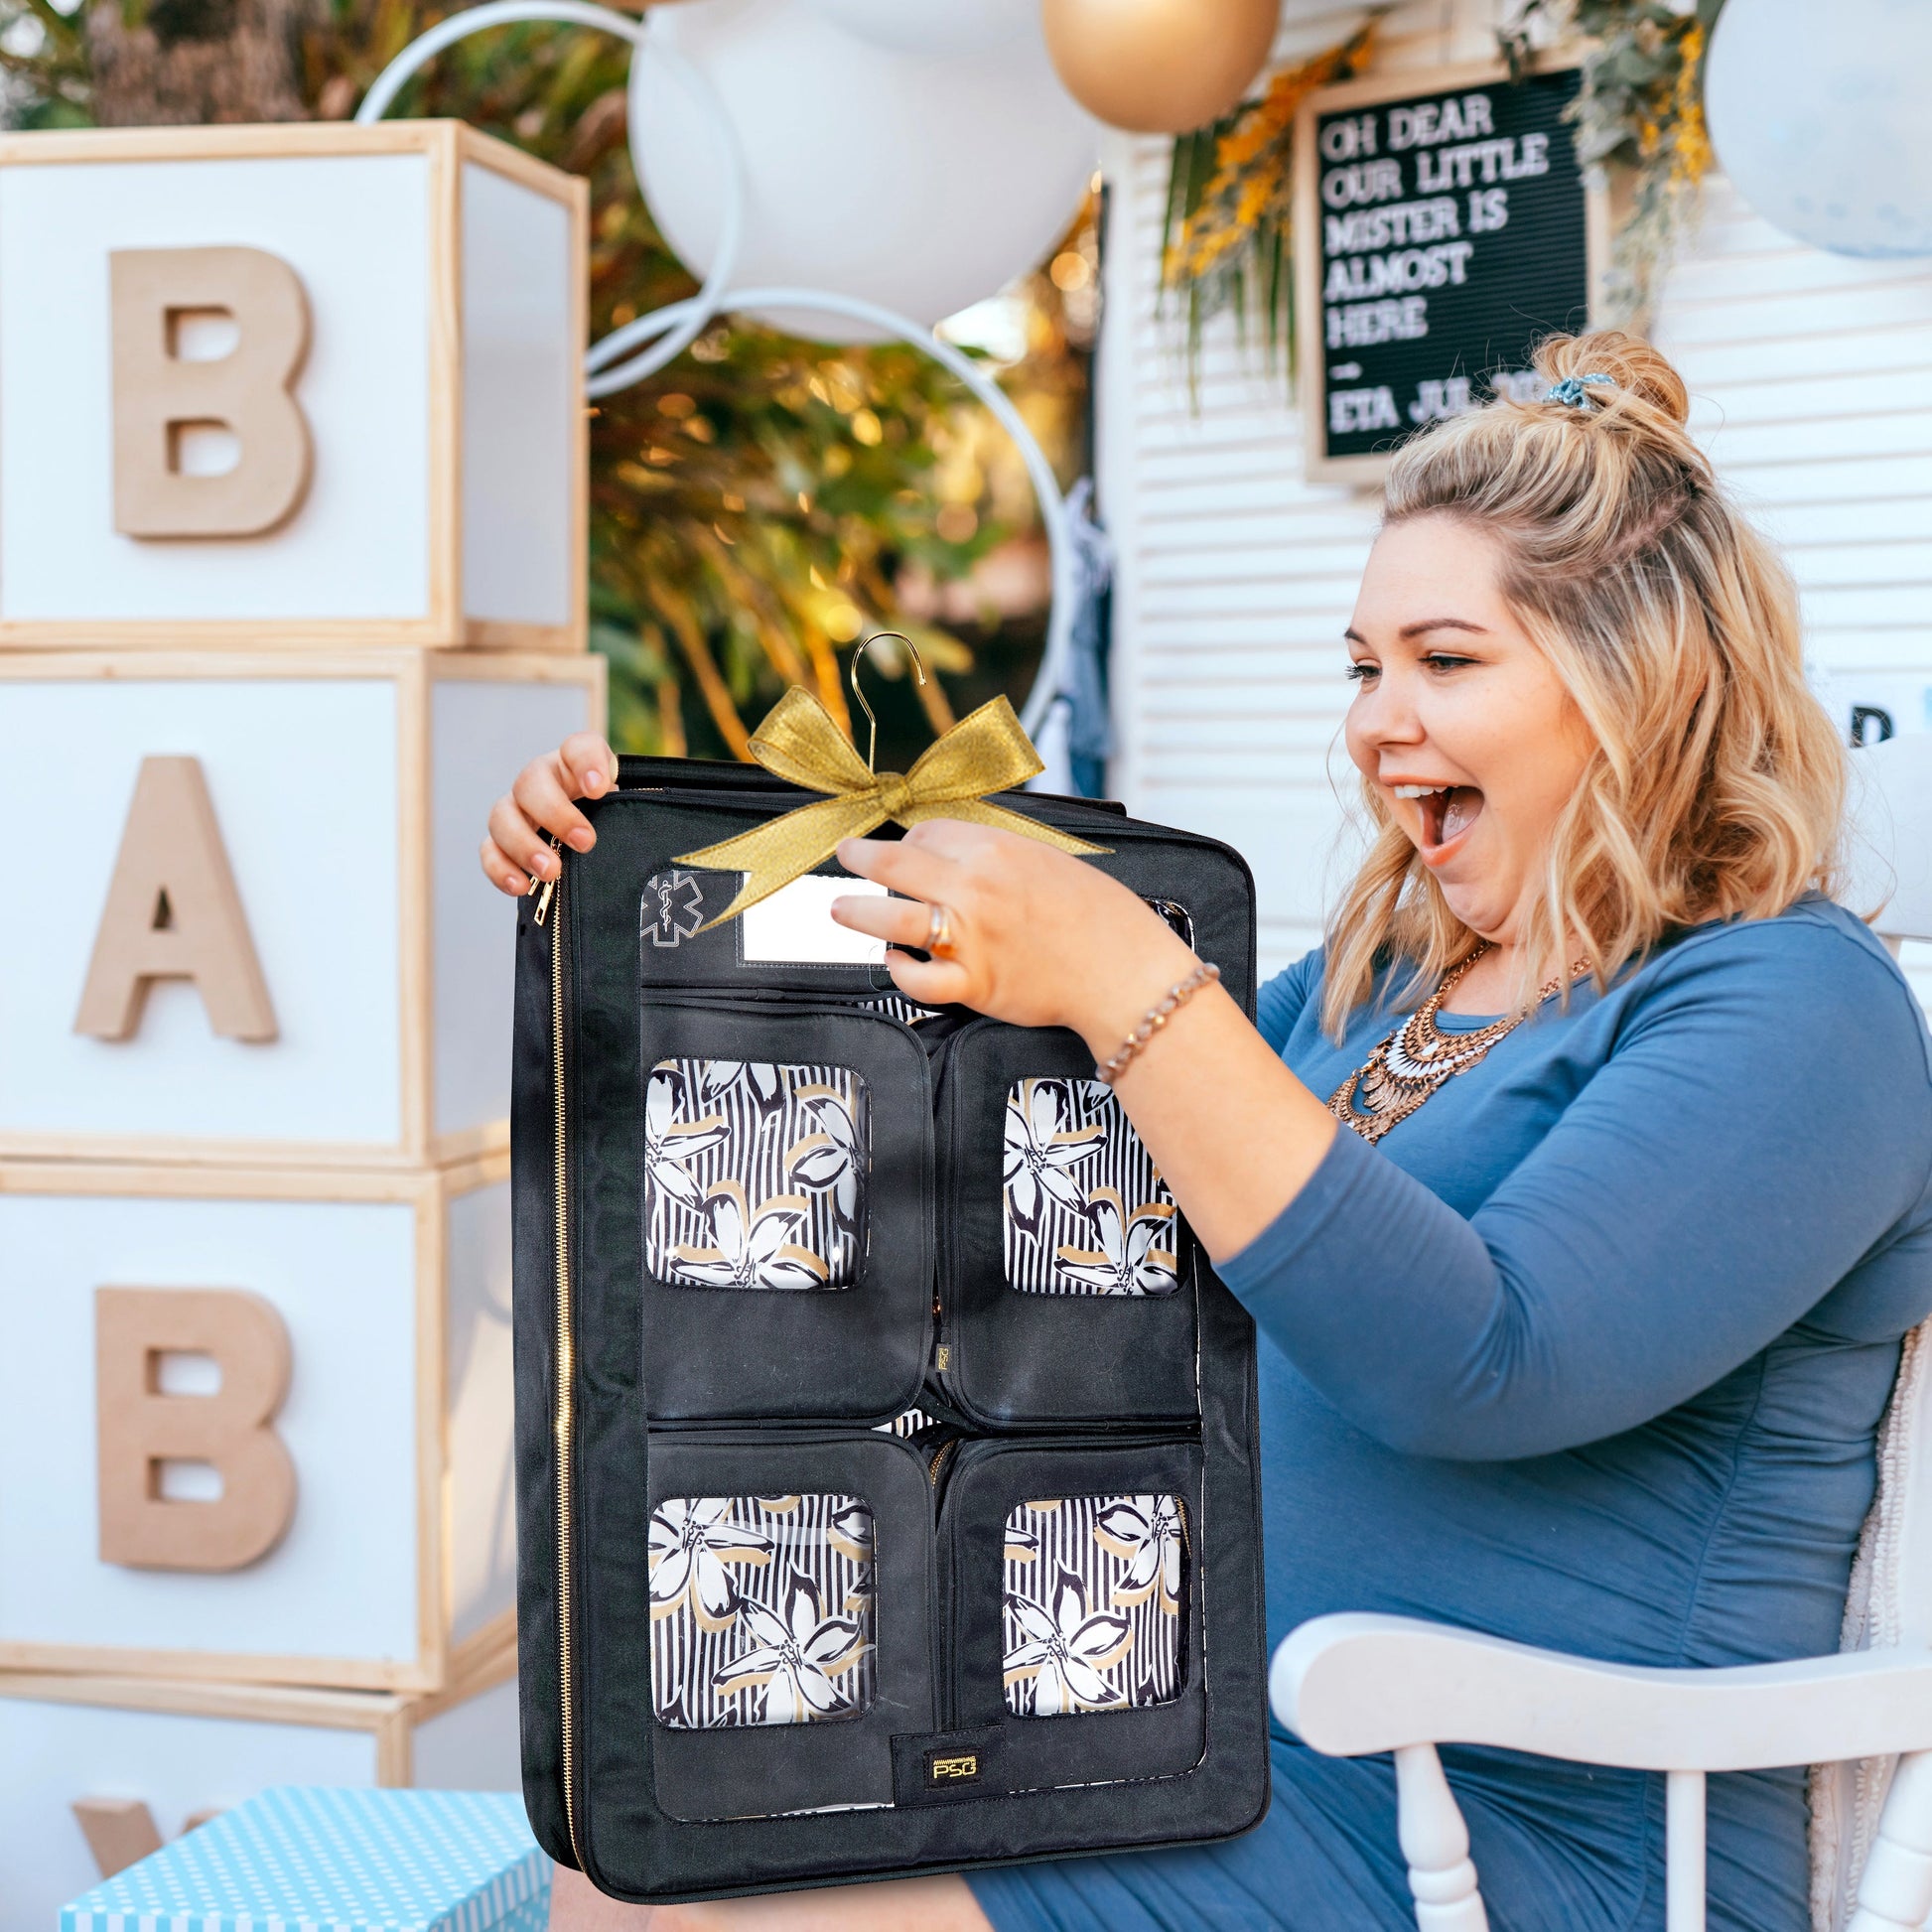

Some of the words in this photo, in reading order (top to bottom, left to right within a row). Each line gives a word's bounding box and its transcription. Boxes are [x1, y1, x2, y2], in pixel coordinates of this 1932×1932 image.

[1321, 114, 1377, 161] OH
[1388, 94, 1493, 152] DEAR
[1322, 158, 1403, 207] OUR
[1416, 132, 1550, 194] LITTLE
[1324, 197, 1460, 255] MISTER
[1469, 189, 1508, 233] IS
[1324, 241, 1473, 302] ALMOST
[1326, 296, 1429, 349] HERE
[109, 245, 316, 542] B
[1329, 384, 1400, 434] ETA
[72, 755, 280, 1044] A
[95, 1285, 299, 1575] B
[933, 1761, 977, 1779] PSG
